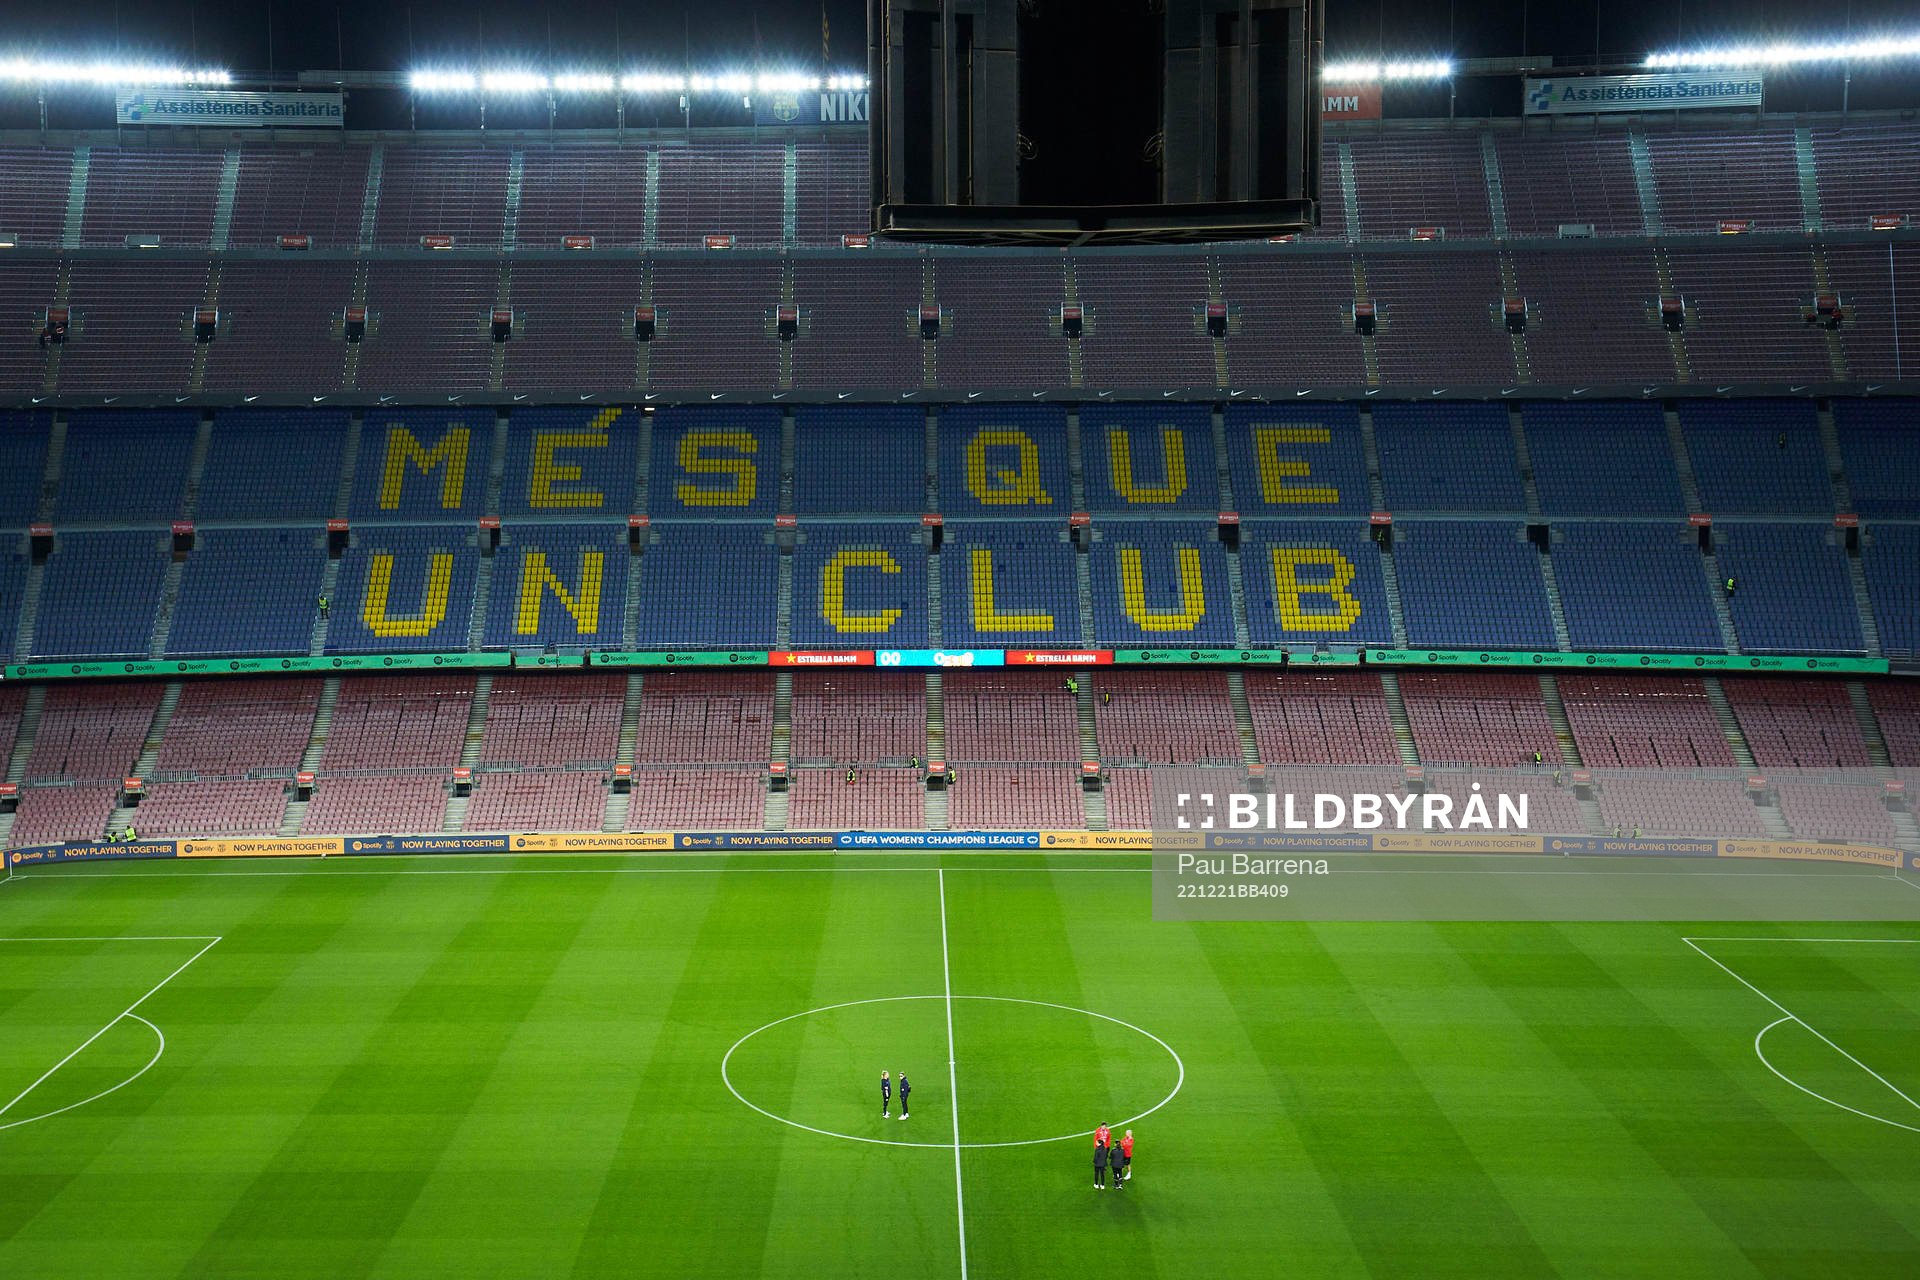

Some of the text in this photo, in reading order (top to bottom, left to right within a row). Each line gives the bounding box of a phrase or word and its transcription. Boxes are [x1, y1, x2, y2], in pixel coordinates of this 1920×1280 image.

[1562, 80, 1761, 101] Assistència Sanitària
[154, 100, 341, 117] Assistència Sanitària
[380, 408, 1339, 509] MÉS QUE
[362, 549, 1361, 637] UN CLUB
[394, 657, 413, 665] Spotify
[444, 656, 463, 664] Spotify
[675, 654, 695, 662] Spotify
[739, 654, 758, 662] Spotify
[797, 655, 857, 663] ESTRELLA DAMM
[1035, 655, 1071, 663] ESTRELLA
[1387, 653, 1406, 661] Spotify
[1438, 654, 1458, 662] Spotify
[1491, 654, 1511, 662] Spotify
[1543, 655, 1564, 663] Spotify
[1597, 656, 1617, 664] Spotify
[1651, 657, 1671, 665] Spotify
[241, 661, 261, 670] Spotify
[292, 660, 312, 668] Spotify
[343, 658, 362, 666] Spotify
[1706, 658, 1727, 666] Spotify
[1818, 660, 1839, 668] Spotify
[82, 665, 103, 673] Spotify
[135, 664, 155, 672] Spotify
[188, 662, 208, 671] Spotify
[28, 667, 48, 675] Spotify
[527, 838, 667, 847] Spotify NOW PLAYING TOGETHER
[692, 836, 833, 845] Spotify NOW PLAYING TOGETHER
[855, 836, 1024, 844] UEFA WOMEN'S CHAMPIONS LEAGUE
[1056, 836, 1199, 845] Spotify NOW PLAYING TOGETHER
[1263, 838, 1285, 846] NOW
[1287, 838, 1322, 846] PLAYING
[1324, 838, 1368, 846] TOGETHER
[1430, 840, 1452, 848] NOW
[1454, 840, 1490, 848] PLAYING
[1491, 840, 1536, 848] TOGETHER
[194, 842, 337, 853] Spotify NOW PLAYING TOGETHER
[363, 840, 505, 850] Spotify NOW PLAYING TOGETHER
[1604, 842, 1627, 850] NOW
[1628, 843, 1665, 851] PLAYING
[1666, 843, 1713, 852] TOGETHER
[23, 845, 173, 860] Spotify NOW PLAYING TOGETHER
[1805, 848, 1845, 857] PLAYING
[1847, 850, 1897, 861] TOGETHER
